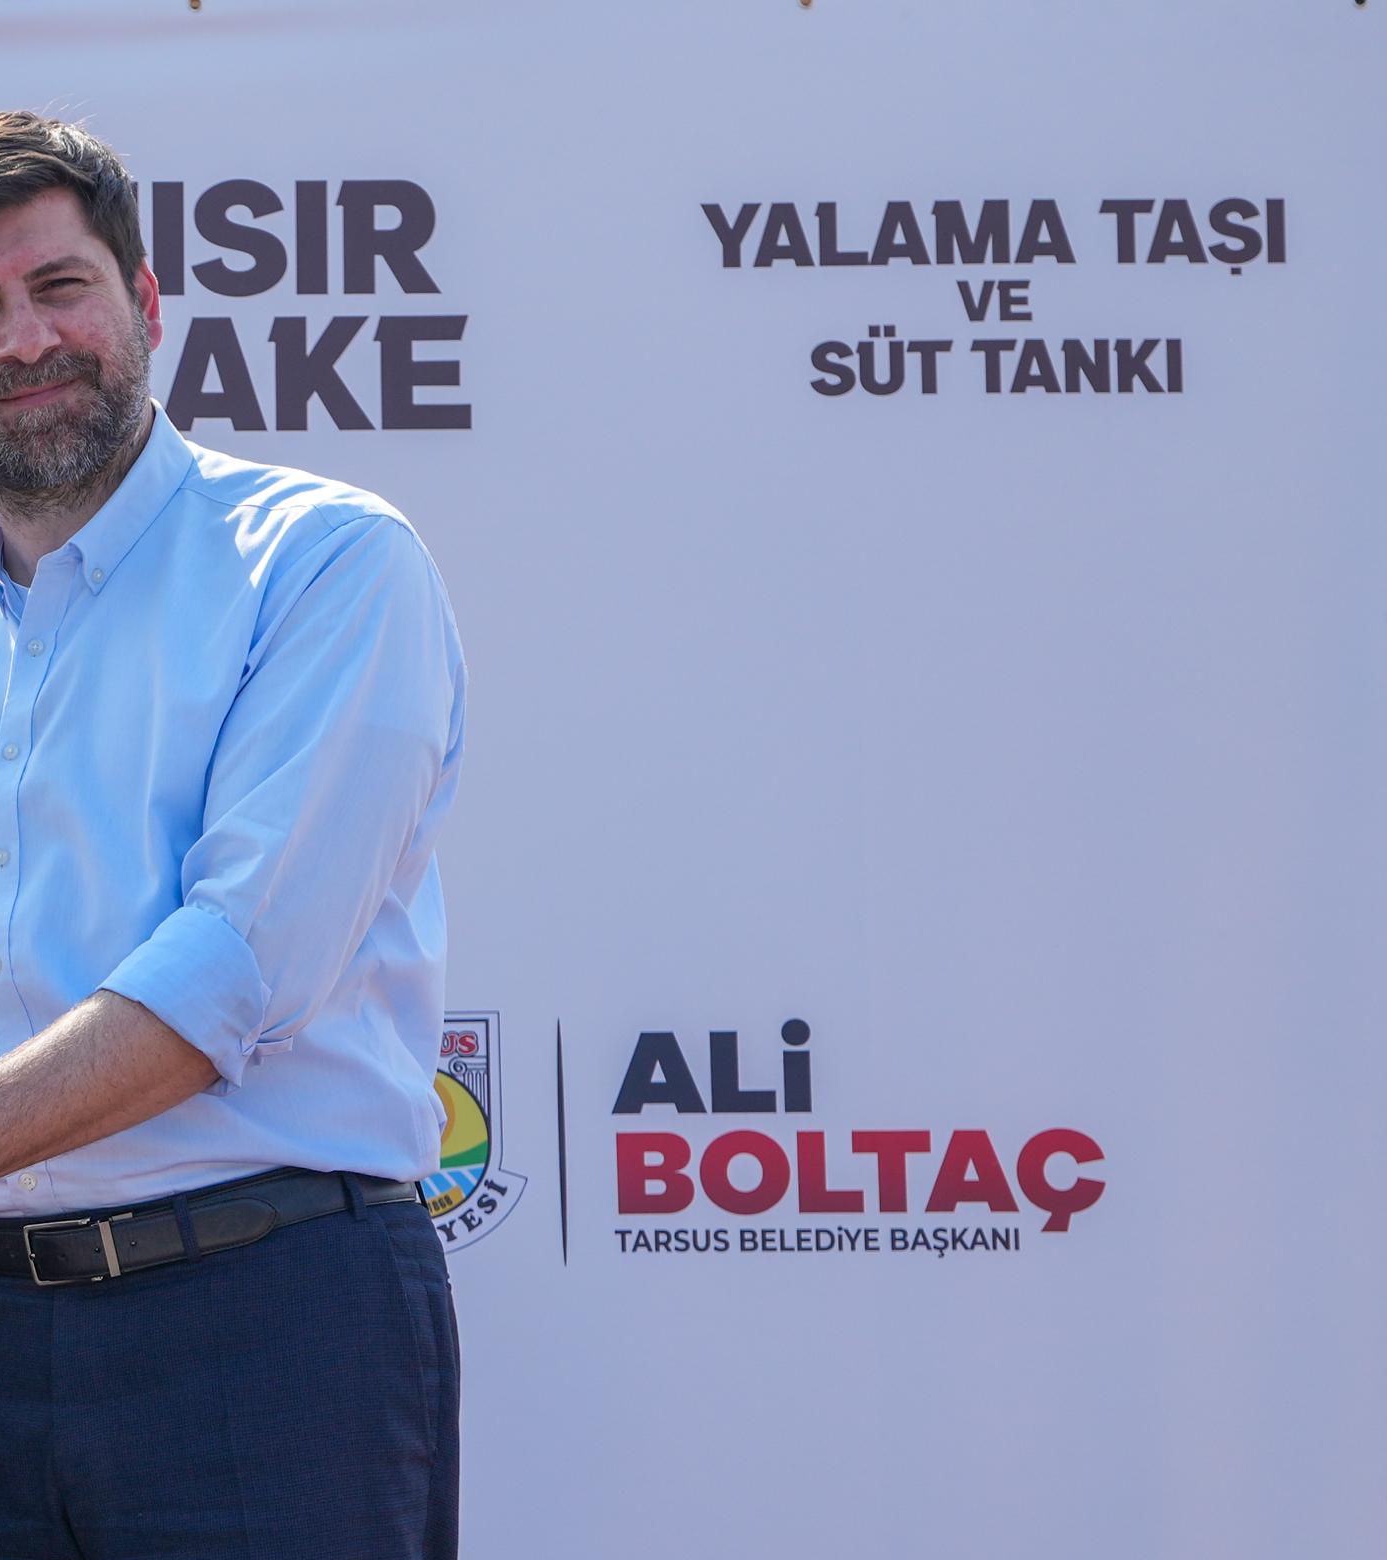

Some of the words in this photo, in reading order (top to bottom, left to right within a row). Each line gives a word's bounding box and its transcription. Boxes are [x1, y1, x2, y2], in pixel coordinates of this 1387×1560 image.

[131, 178, 442, 297] ISIR
[700, 198, 1076, 268] YALAMA
[1099, 198, 1286, 276] TAŞI
[956, 280, 1033, 321] VE
[165, 314, 472, 431] AKE
[810, 325, 954, 396] SÜT
[970, 338, 1183, 394] TANKI
[615, 1128, 1107, 1233] BOLTAÇ
[615, 1228, 731, 1254] TARSUS
[890, 1227, 1022, 1259] BAŞKANI
